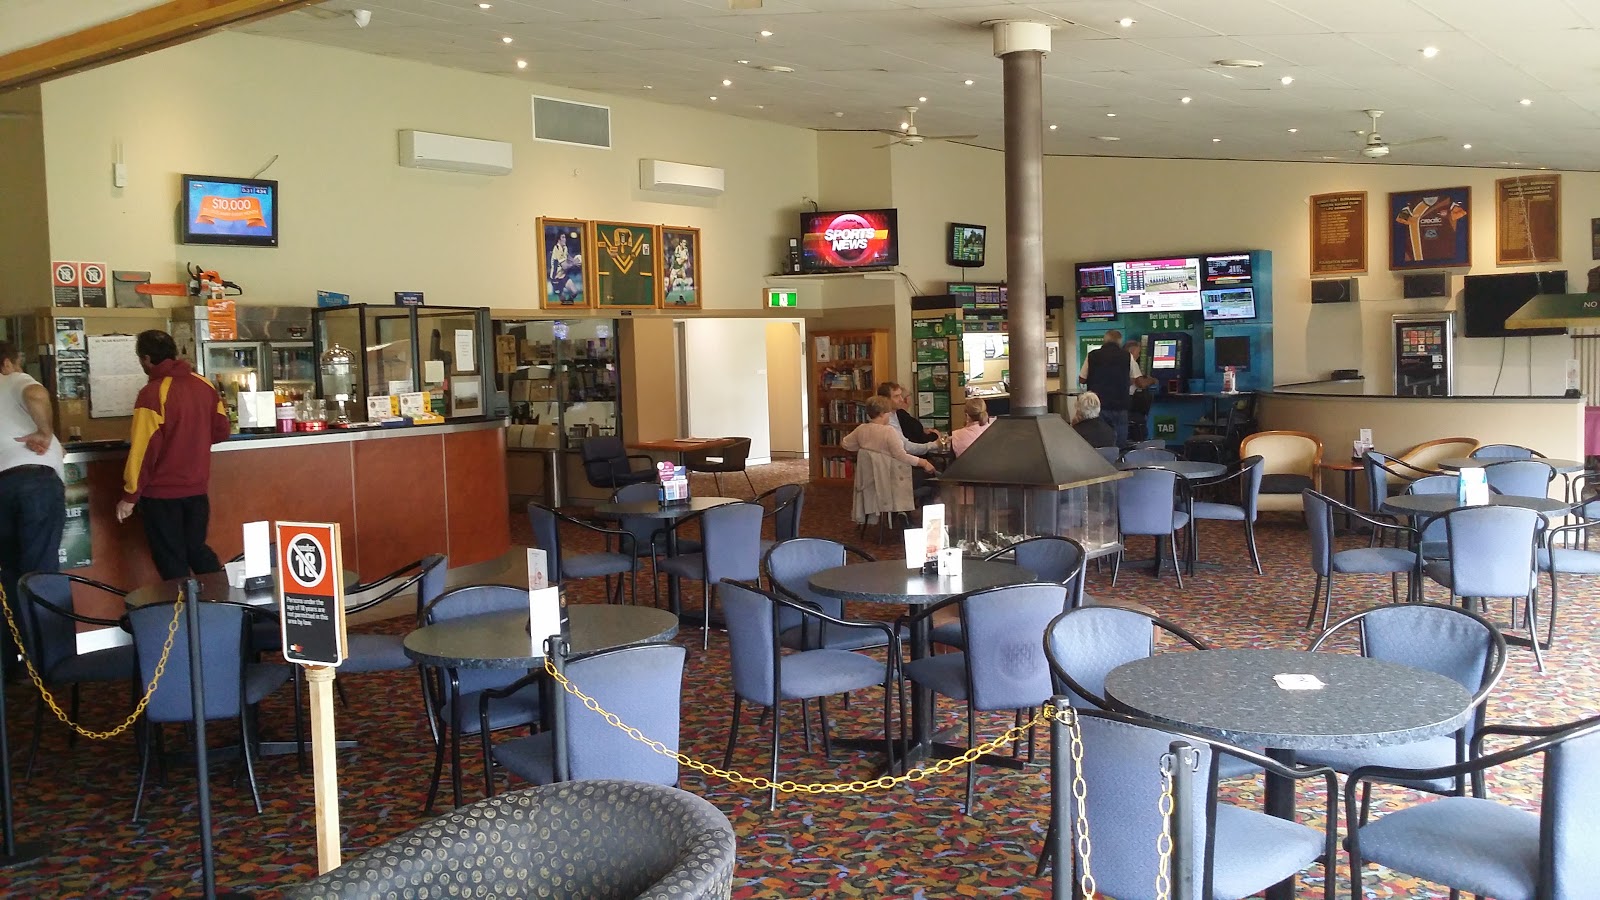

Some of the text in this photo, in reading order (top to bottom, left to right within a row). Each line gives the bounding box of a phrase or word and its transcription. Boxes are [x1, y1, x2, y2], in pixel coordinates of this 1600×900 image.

[212, 198, 251, 211] $10,000
[824, 227, 875, 241] SPORTS
[831, 239, 868, 251] NEWS
[1157, 424, 1175, 432] TAB
[295, 552, 317, 578] 18
[286, 596, 303, 604] Persons
[297, 618, 303, 626] by
